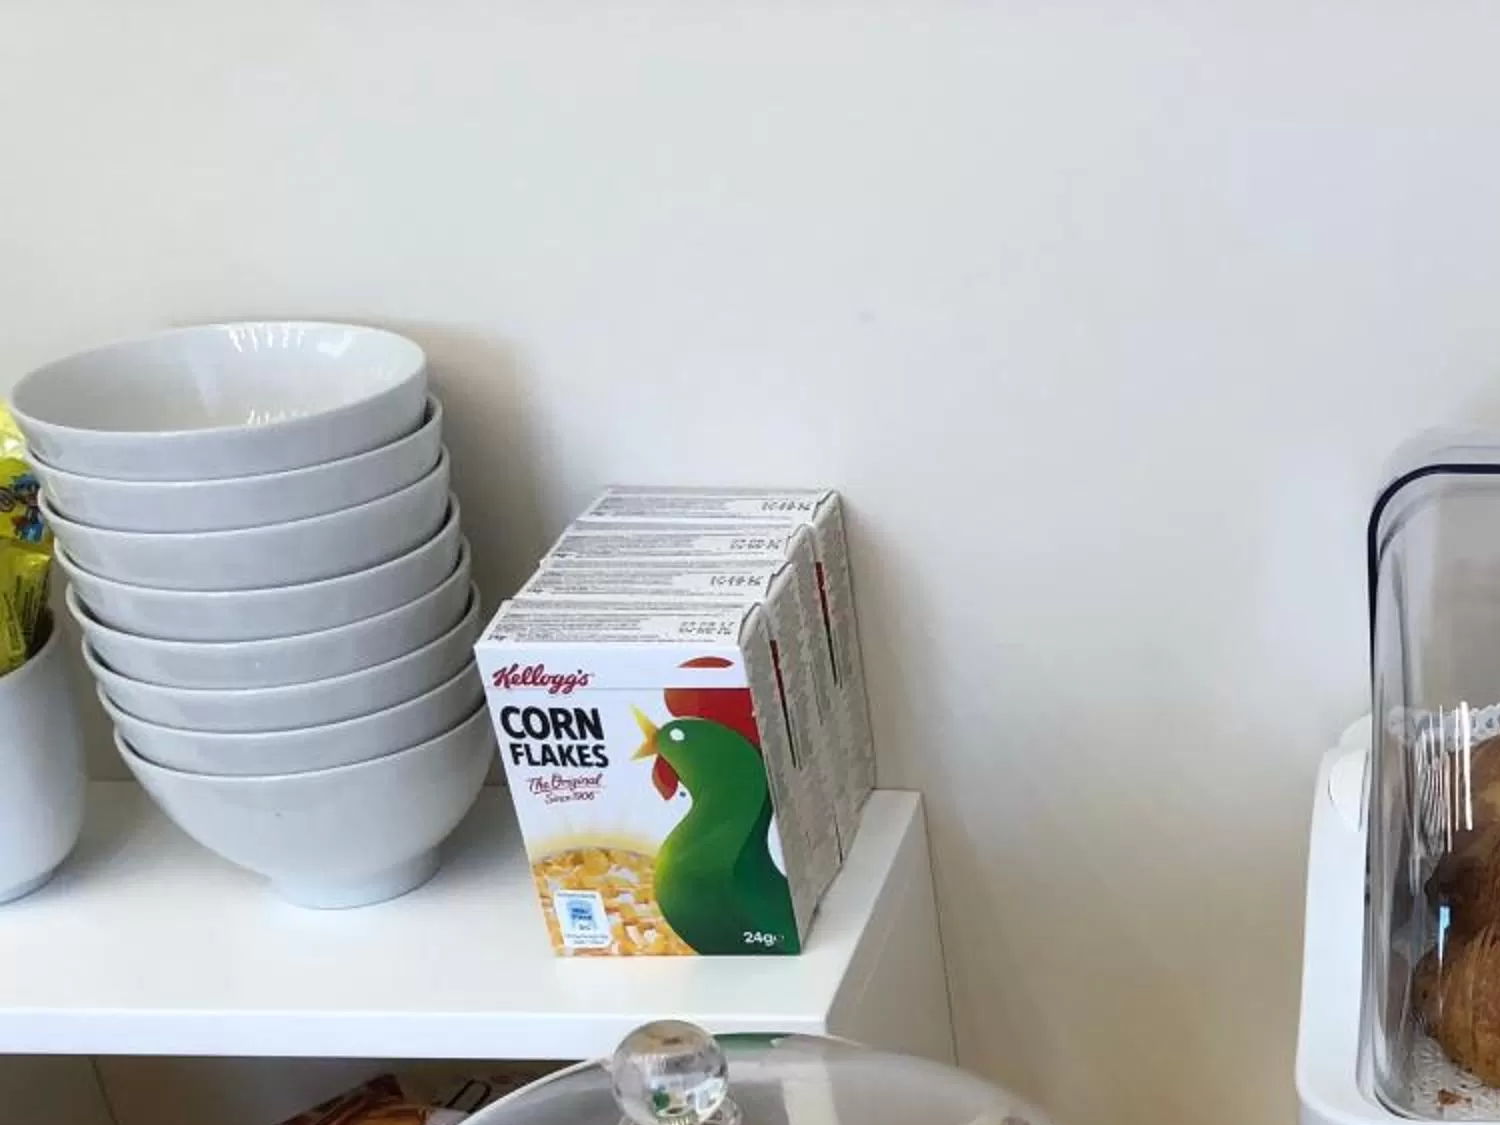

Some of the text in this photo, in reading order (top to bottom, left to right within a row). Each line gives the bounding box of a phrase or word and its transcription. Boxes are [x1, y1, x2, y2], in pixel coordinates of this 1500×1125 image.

[493, 663, 590, 694] Kellogg's
[501, 706, 604, 740] CORN
[510, 743, 609, 768] FLAKES
